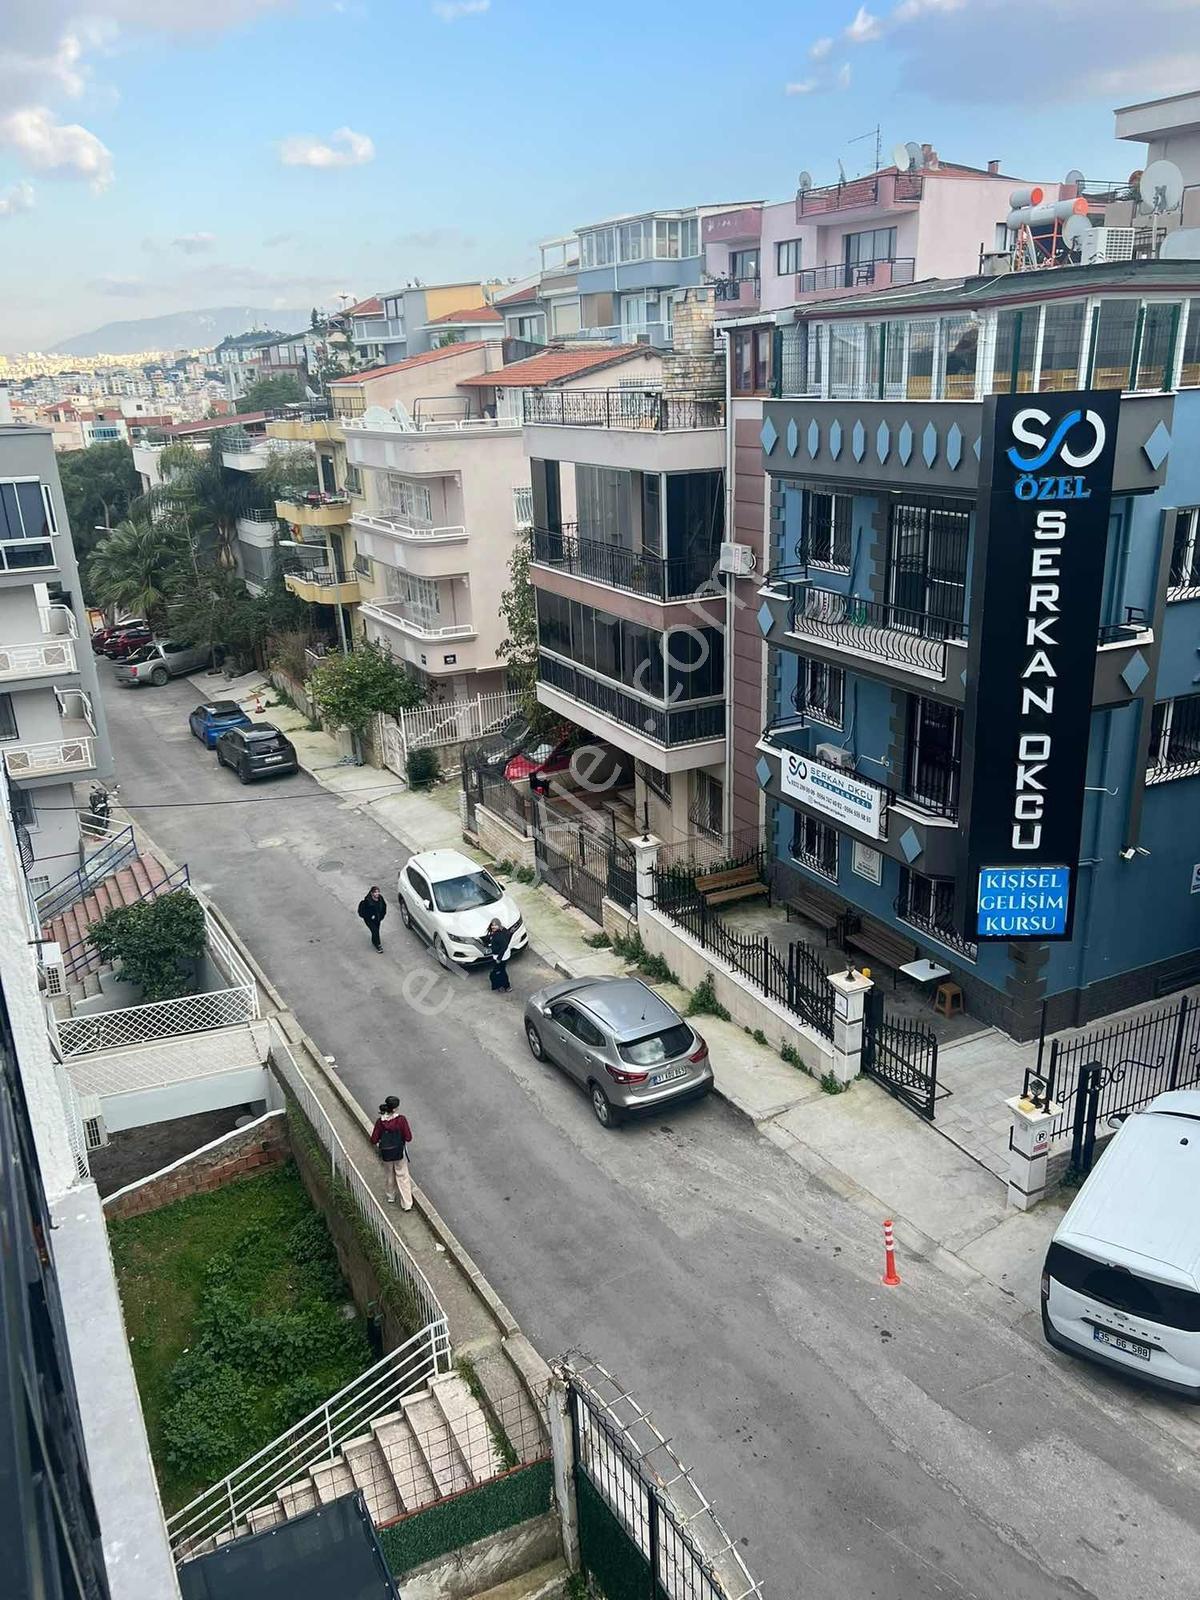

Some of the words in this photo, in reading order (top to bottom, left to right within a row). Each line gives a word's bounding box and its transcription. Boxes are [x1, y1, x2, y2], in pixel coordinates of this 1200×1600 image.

[1014, 473, 1092, 501] ÖZEL
[1021, 510, 1067, 715] SERKAN
[810, 767, 845, 788] SERKAN
[848, 784, 873, 802] OKCU
[1011, 734, 1051, 850] OKCU
[986, 871, 1062, 891] KİŞİSEL
[980, 892, 1064, 912] GELİŞİM
[986, 916, 1056, 931] KURSU
[1099, 1332, 1109, 1342] 35
